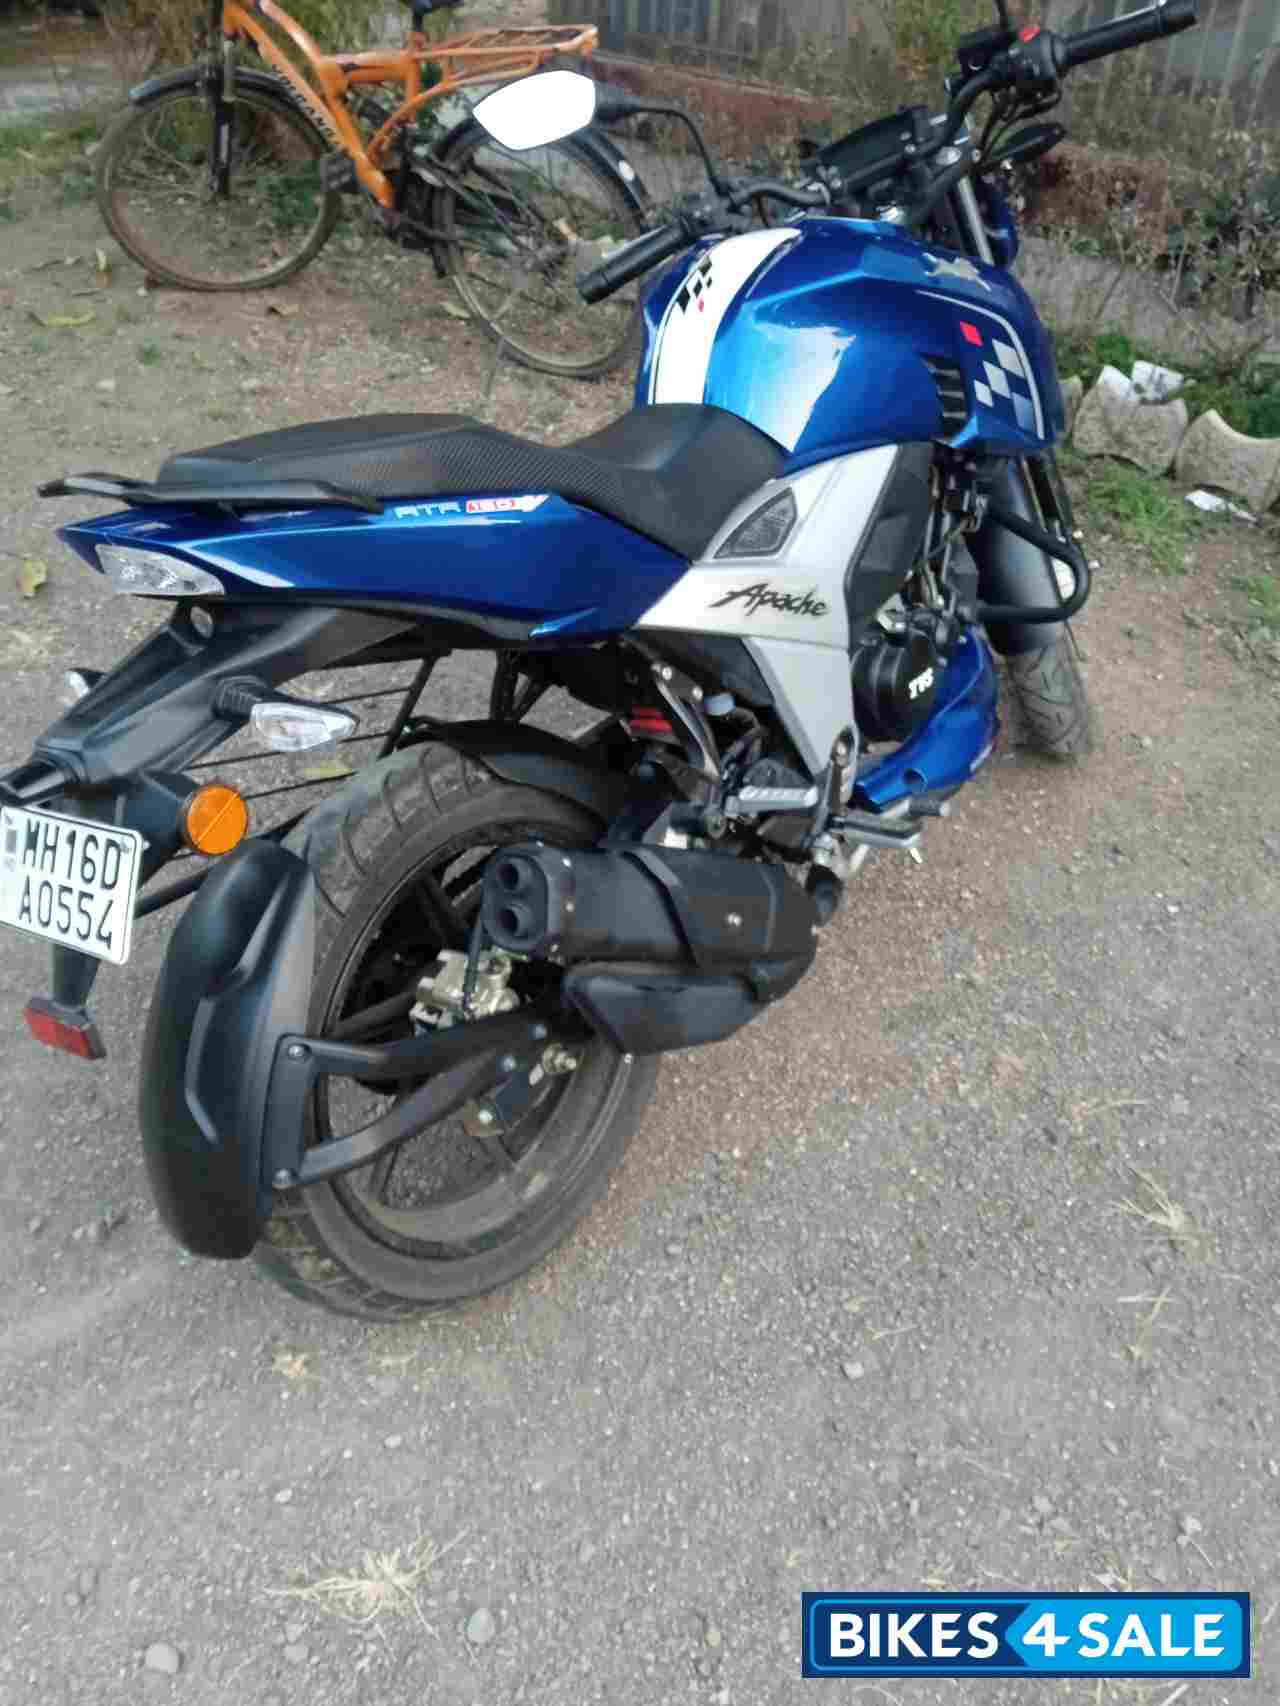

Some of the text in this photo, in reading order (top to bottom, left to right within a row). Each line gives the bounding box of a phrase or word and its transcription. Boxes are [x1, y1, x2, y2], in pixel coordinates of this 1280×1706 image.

[708, 583, 829, 616] Apache
[909, 667, 934, 699] TVS
[23, 818, 121, 890] MH16D
[19, 874, 113, 950] A0554
